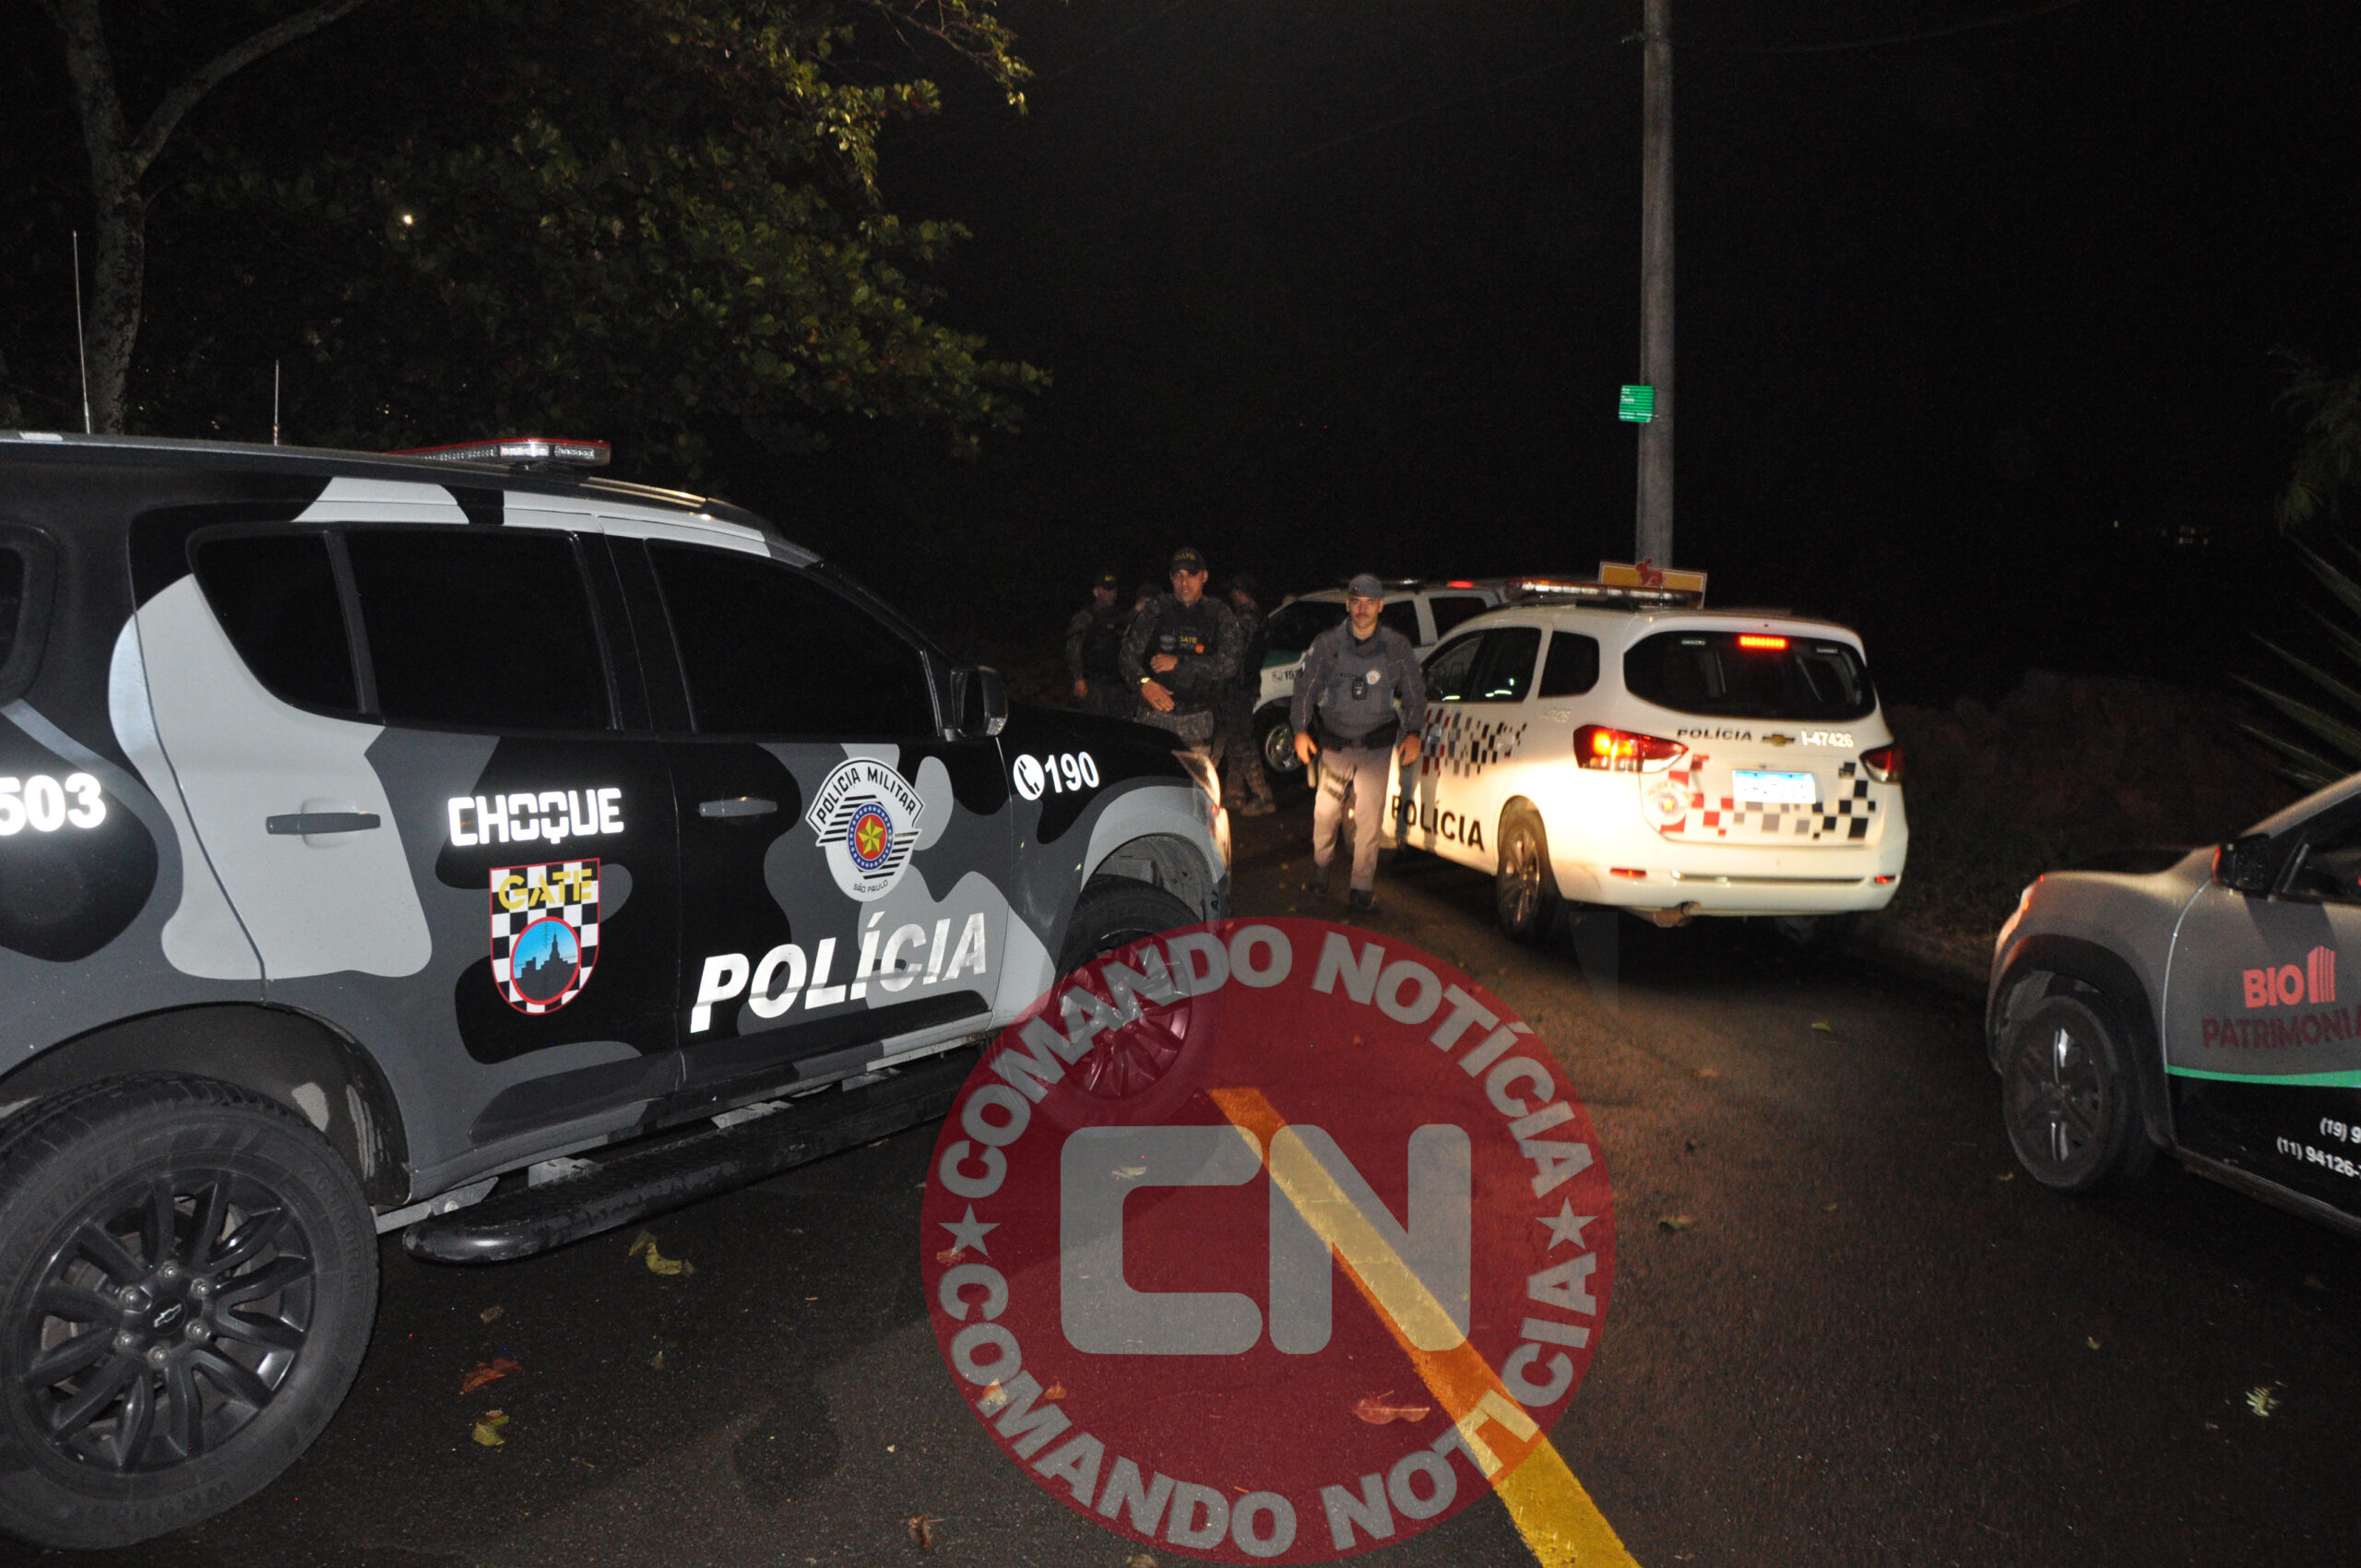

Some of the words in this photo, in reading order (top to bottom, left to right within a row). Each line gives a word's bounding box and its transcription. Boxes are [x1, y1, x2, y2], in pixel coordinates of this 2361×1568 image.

[1677, 728, 1752, 742] POLÍCIA
[1044, 751, 1100, 794] 190
[0, 772, 107, 836] 503
[447, 787, 624, 847] CHOQUE
[815, 767, 861, 825] POLÍCIA
[867, 766, 917, 815] MILITAR
[498, 868, 593, 910] GATE
[867, 879, 889, 893] PAULO
[690, 911, 987, 1034] POLÍCIA
[2243, 964, 2305, 1008] BIO
[2201, 1004, 2361, 1049] PATRIMONI
[2276, 1136, 2303, 1160] (11)
[2319, 1117, 2347, 1142] (19)
